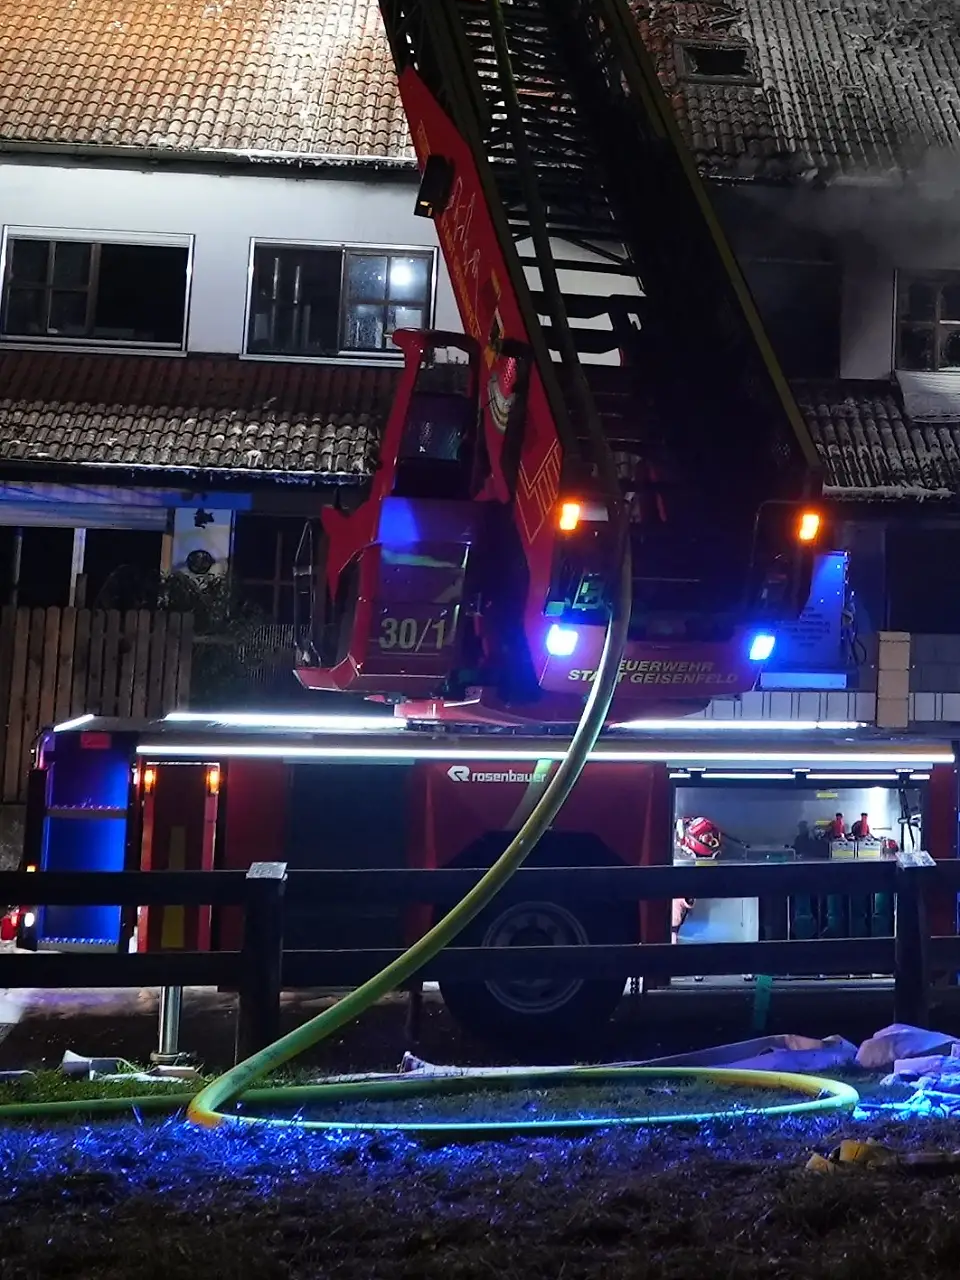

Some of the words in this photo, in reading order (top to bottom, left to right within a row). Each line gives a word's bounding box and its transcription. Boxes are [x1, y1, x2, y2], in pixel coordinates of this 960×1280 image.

[379, 617, 446, 652] 30/1
[619, 659, 715, 672] EUERWEHR
[568, 669, 628, 682] STAT
[630, 672, 738, 684] GEISENFELD
[472, 769, 547, 783] rosenbauer
